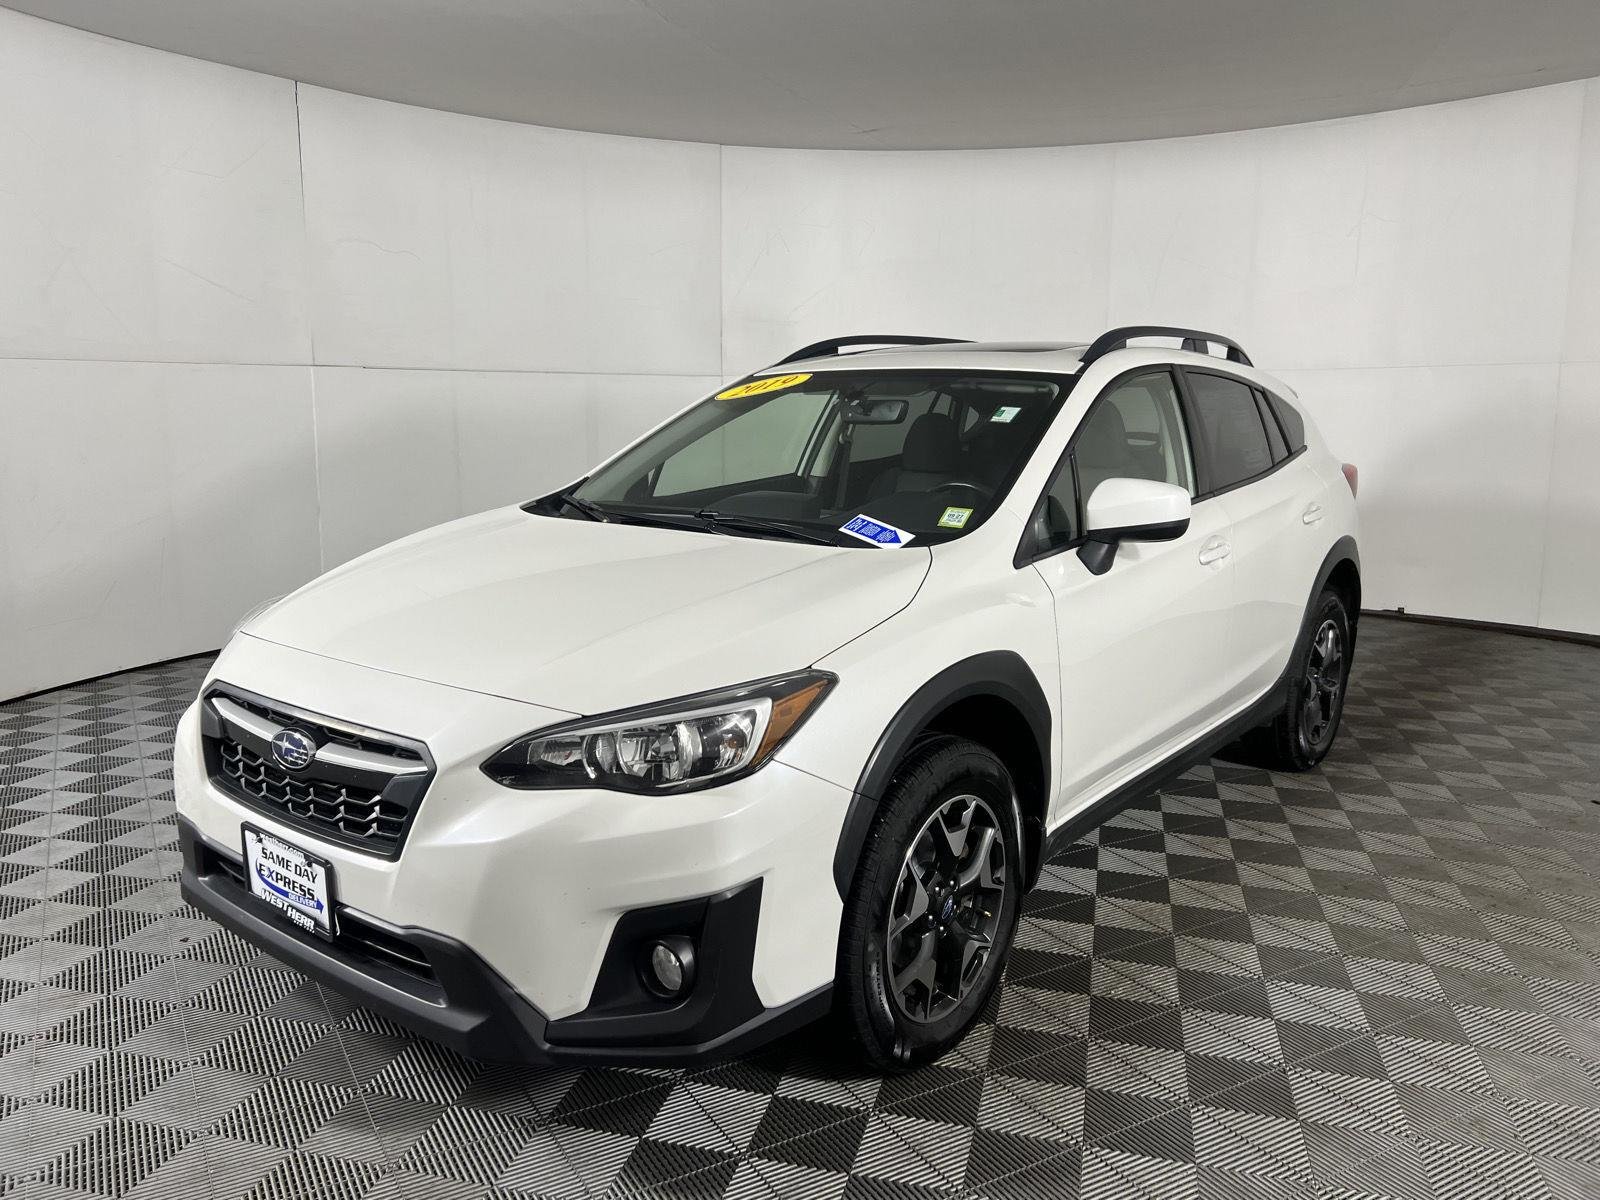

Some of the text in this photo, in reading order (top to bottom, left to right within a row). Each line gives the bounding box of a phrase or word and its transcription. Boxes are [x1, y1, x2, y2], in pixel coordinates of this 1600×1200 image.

[728, 374, 800, 398] 2019
[261, 847, 318, 884] SAME DAY
[258, 863, 315, 900] EXPRESS
[288, 892, 318, 909] DELIVERY
